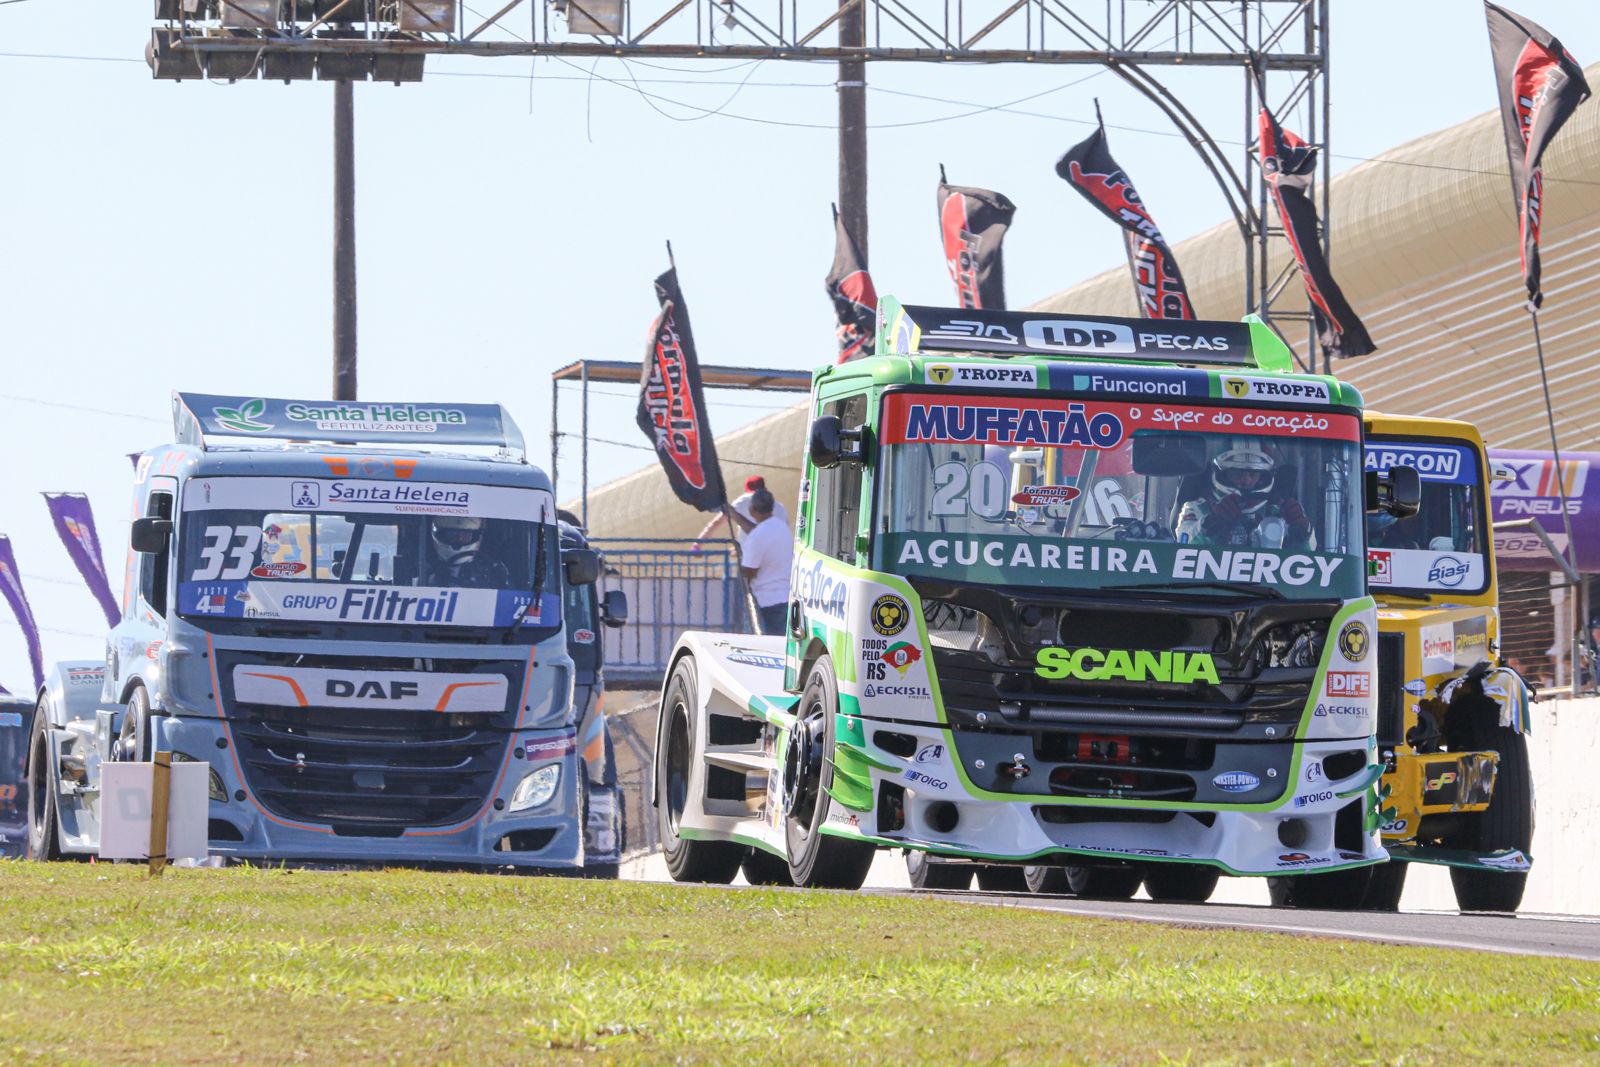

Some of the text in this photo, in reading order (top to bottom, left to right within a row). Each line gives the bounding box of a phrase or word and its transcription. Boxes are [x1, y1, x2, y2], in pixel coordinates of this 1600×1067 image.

[1042, 326, 1229, 353] LDP PEÇAS
[958, 367, 1034, 384] TROPPA
[1092, 375, 1187, 396] Funcional
[1253, 382, 1327, 399] TROPPA
[288, 405, 465, 424] Santa Helena
[1211, 410, 1233, 427] do
[1242, 413, 1329, 434] coração
[321, 421, 435, 433] FERTILIZANTES
[905, 403, 1124, 449] MUFFATÃO
[329, 482, 470, 503] Santa Helena
[932, 460, 1009, 520] 20
[1030, 496, 1066, 505] TRUCK
[1500, 499, 1583, 514] PNEUS
[395, 505, 470, 515] SUPERMERCADOS
[191, 525, 263, 581] 33
[899, 538, 1344, 587] AÇUCAREIRA ENERGY
[1428, 561, 1470, 582] Biasi
[197, 586, 228, 596] POSTO
[195, 595, 211, 613] 4
[282, 588, 458, 622] GRUPO Filtroil
[862, 639, 887, 650] TODOS
[862, 651, 880, 661] PELO
[867, 663, 887, 681] RS
[1034, 647, 1222, 686] SCANIA
[326, 680, 418, 700] DAF
[876, 686, 930, 696] ECKISIL
[1332, 674, 1369, 691] DIFE
[1329, 705, 1369, 715] ECKISIL
[915, 771, 948, 790] TOIGO
[1303, 791, 1333, 804] TOIGO
